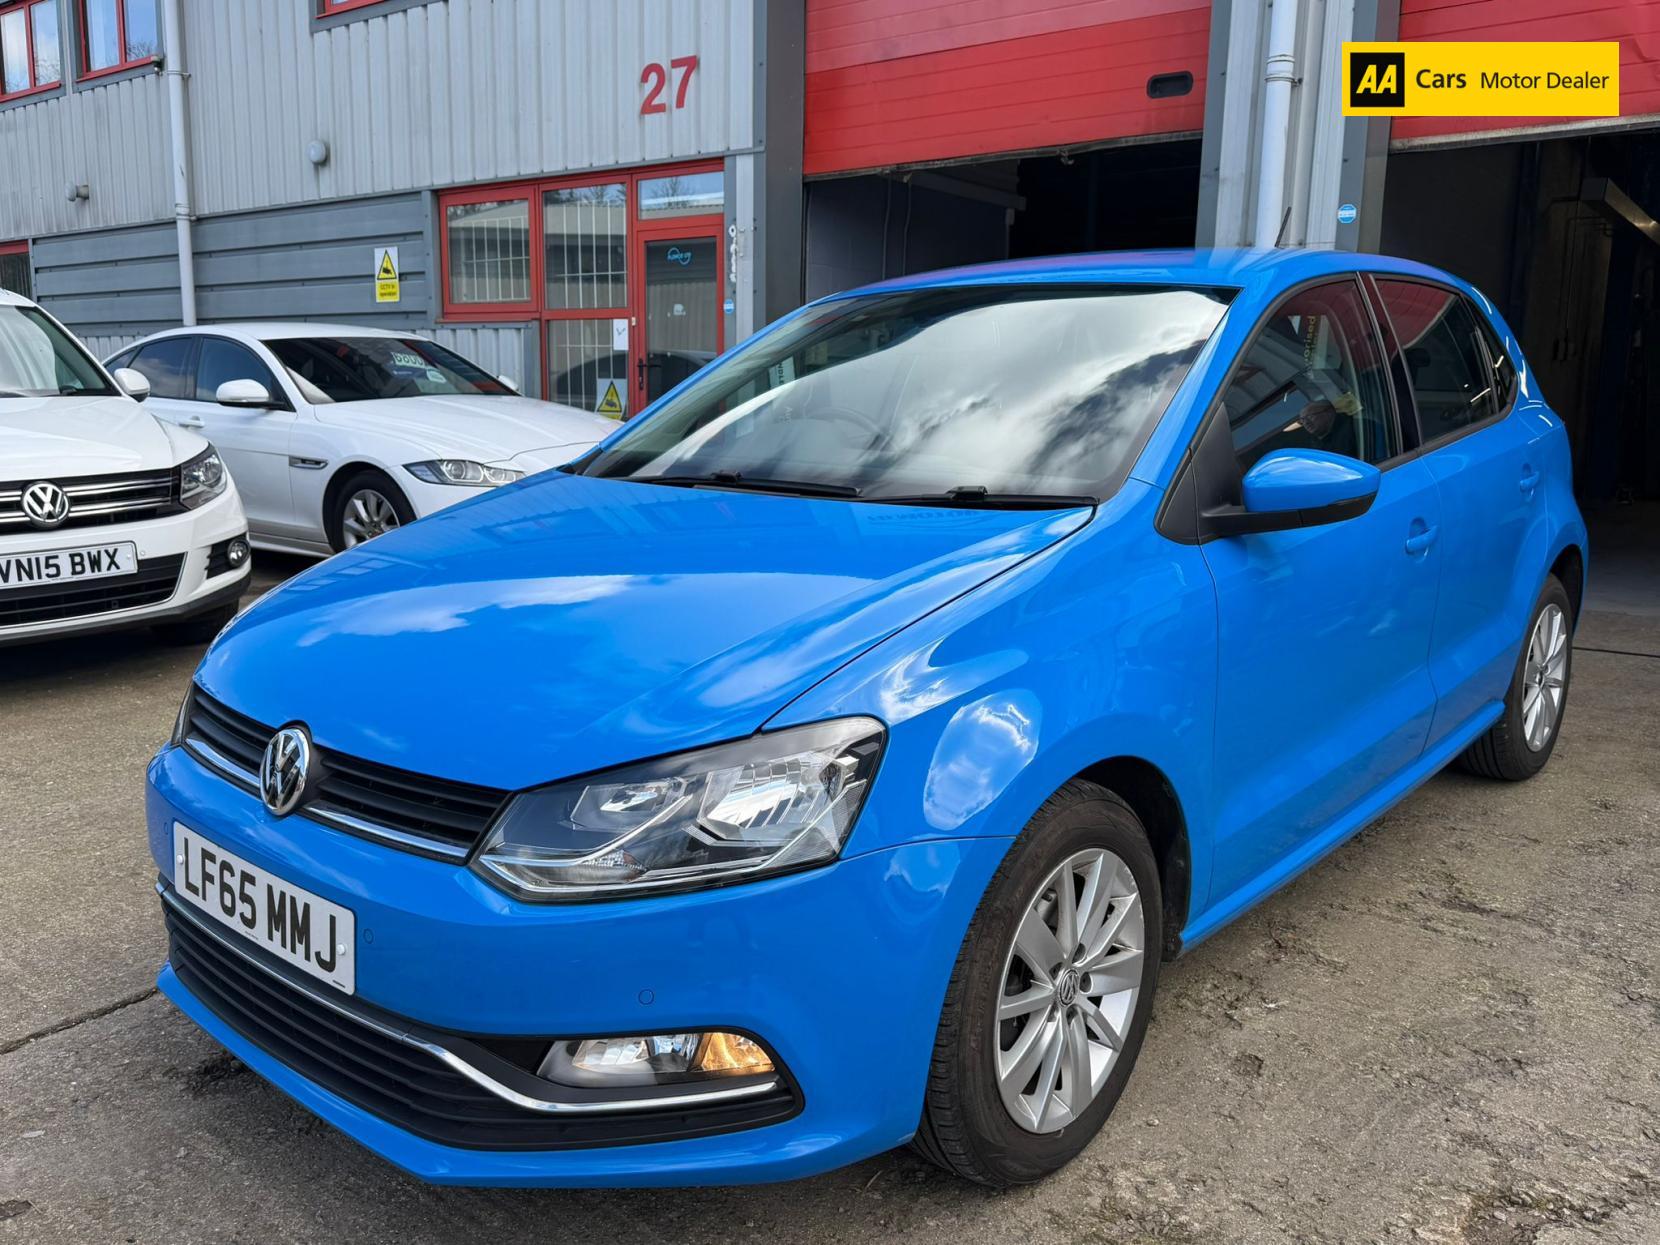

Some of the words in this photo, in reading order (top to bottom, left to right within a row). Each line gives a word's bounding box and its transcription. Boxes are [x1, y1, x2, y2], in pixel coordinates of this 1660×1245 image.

[640, 54, 698, 115] 27
[69, 548, 120, 576] BWX
[184, 837, 257, 930] LF65
[267, 884, 336, 973] MMJ
